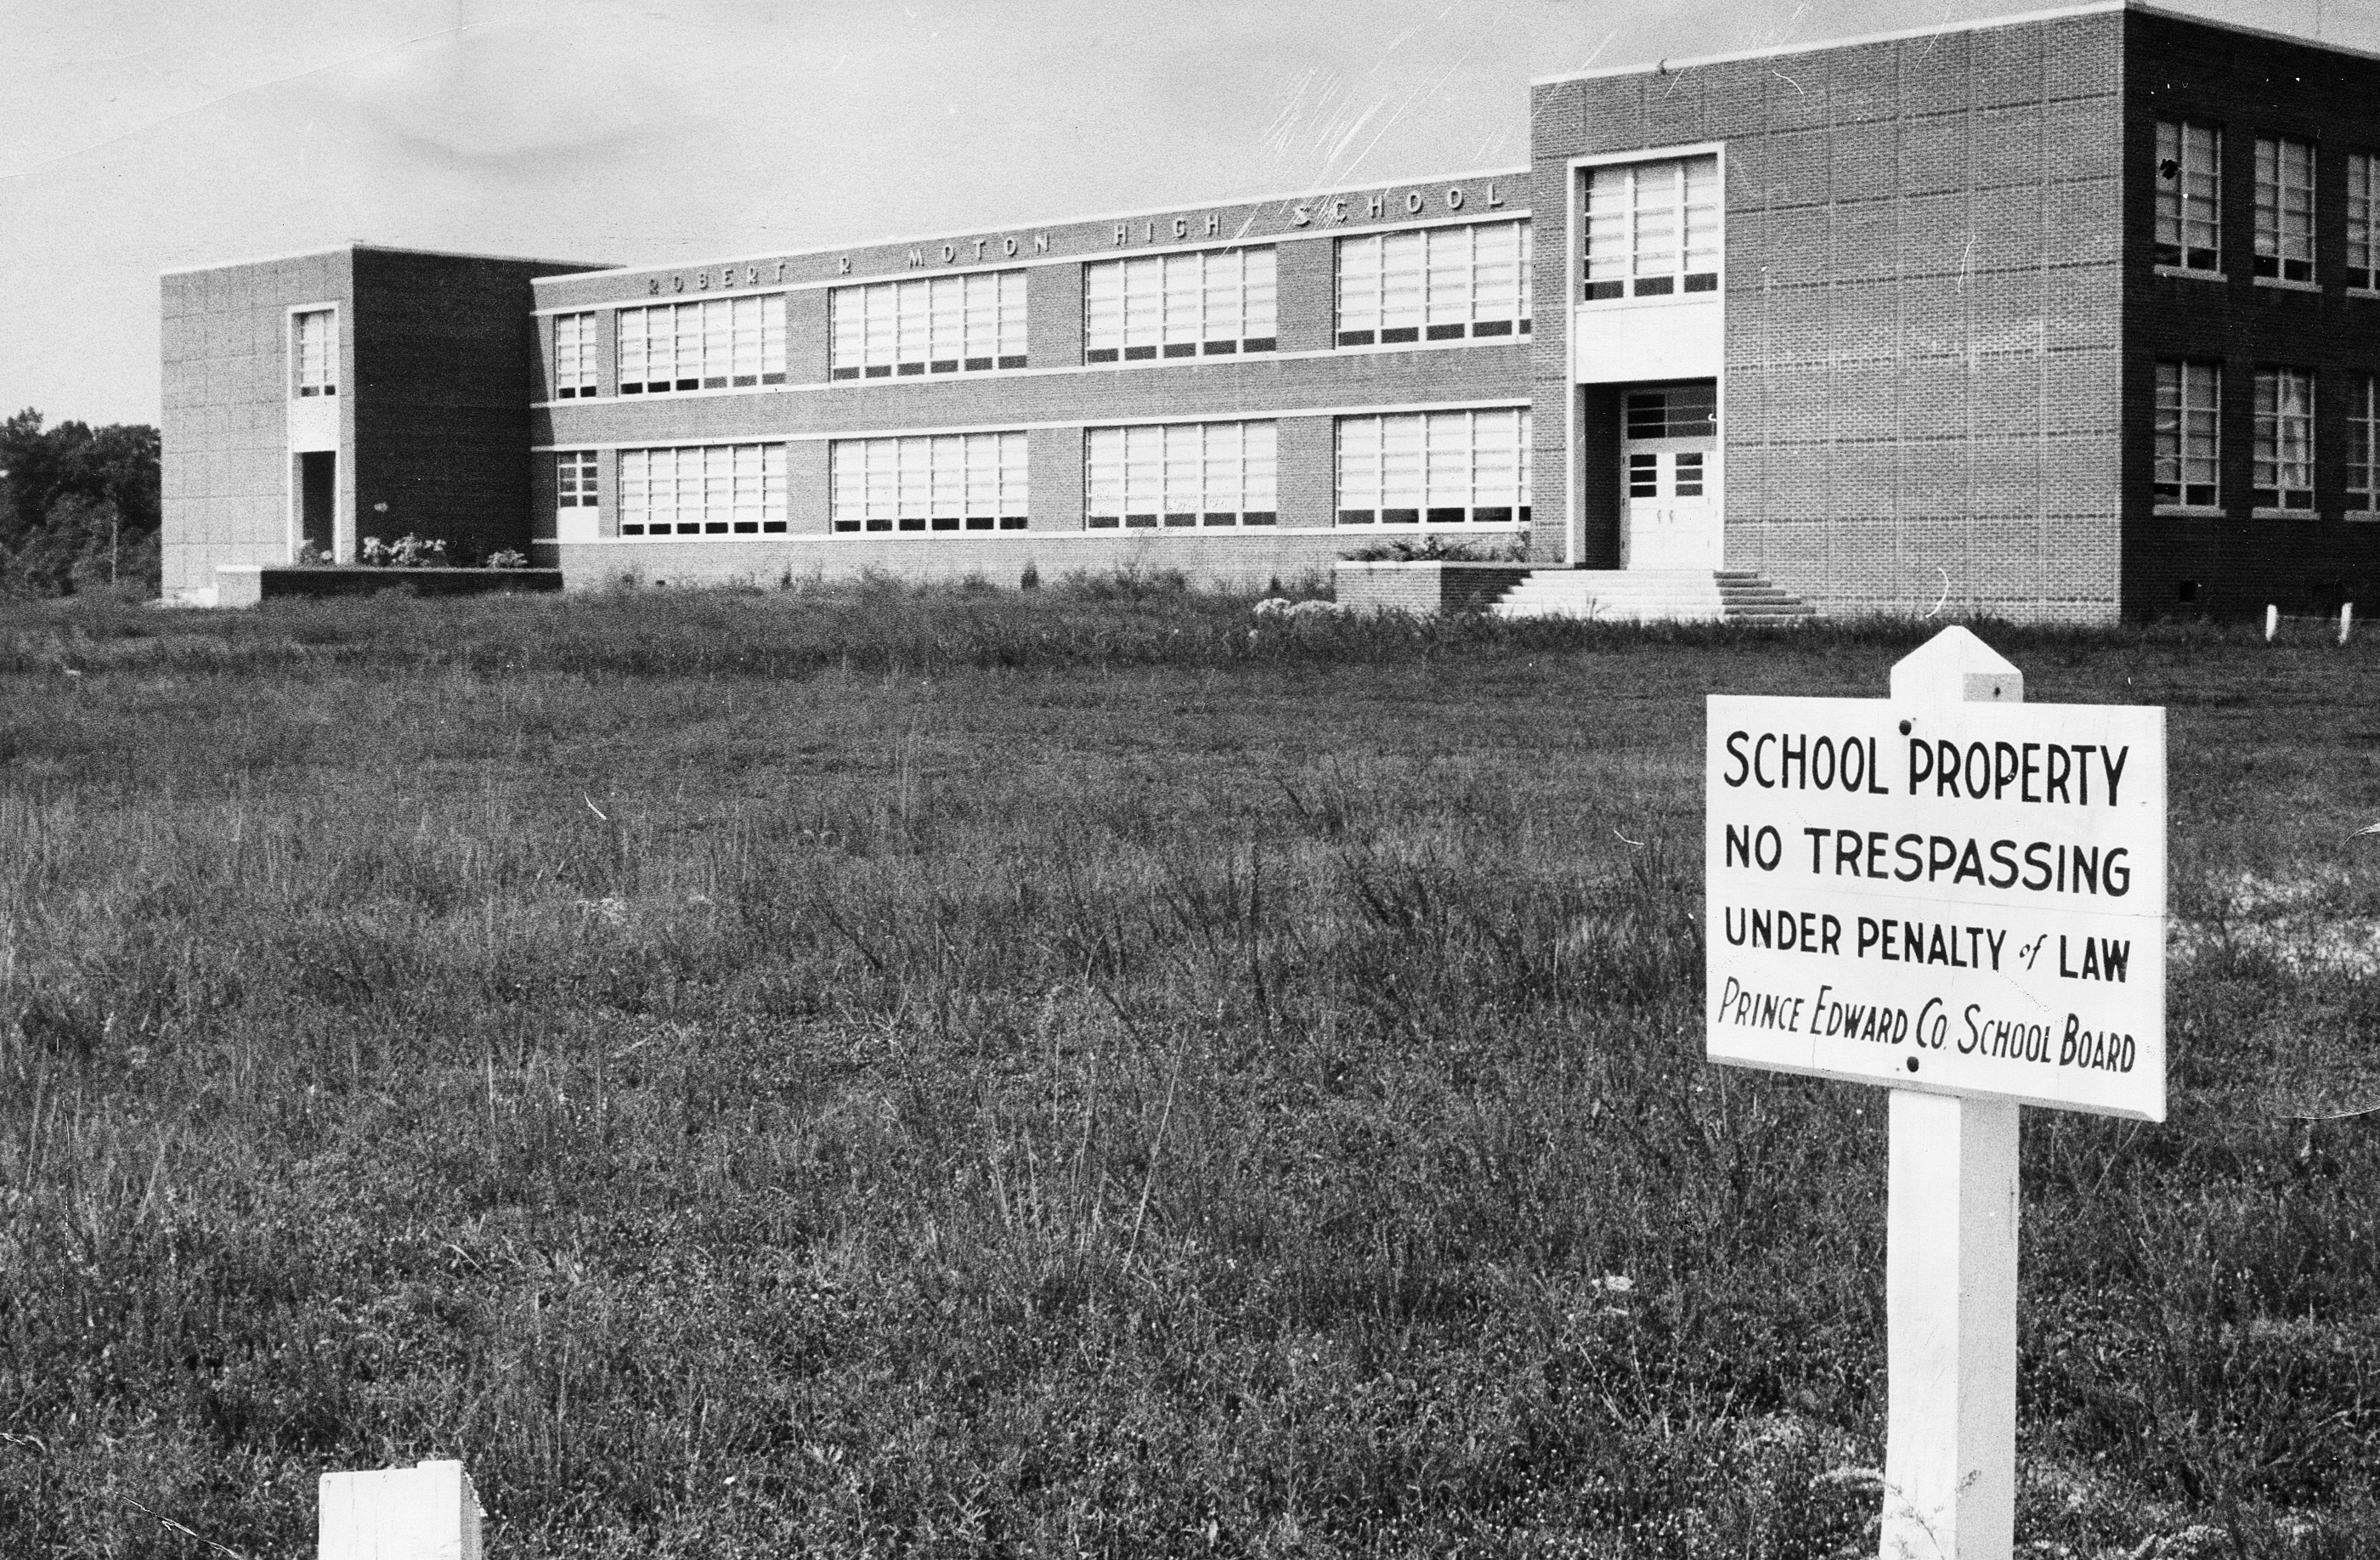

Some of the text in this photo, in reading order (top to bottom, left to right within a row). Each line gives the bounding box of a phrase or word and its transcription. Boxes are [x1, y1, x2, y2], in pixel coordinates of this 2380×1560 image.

[648, 262, 785, 295] ROBERT
[907, 234, 1050, 268] MOTON
[1112, 213, 1221, 246] HIGH
[1293, 184, 1504, 227] SCHOOL
[1724, 731, 2129, 806] SCHOOL PROPERTY
[1726, 823, 2130, 897] NO TRESPASSING
[1724, 907, 2131, 983] UNDER PENALTY of LAW
[1718, 976, 1805, 1032] PRINCE
[1810, 985, 1908, 1044] EDWARD
[1958, 1003, 2052, 1064] SCHOOL
[2059, 1014, 2136, 1073] BOARD
